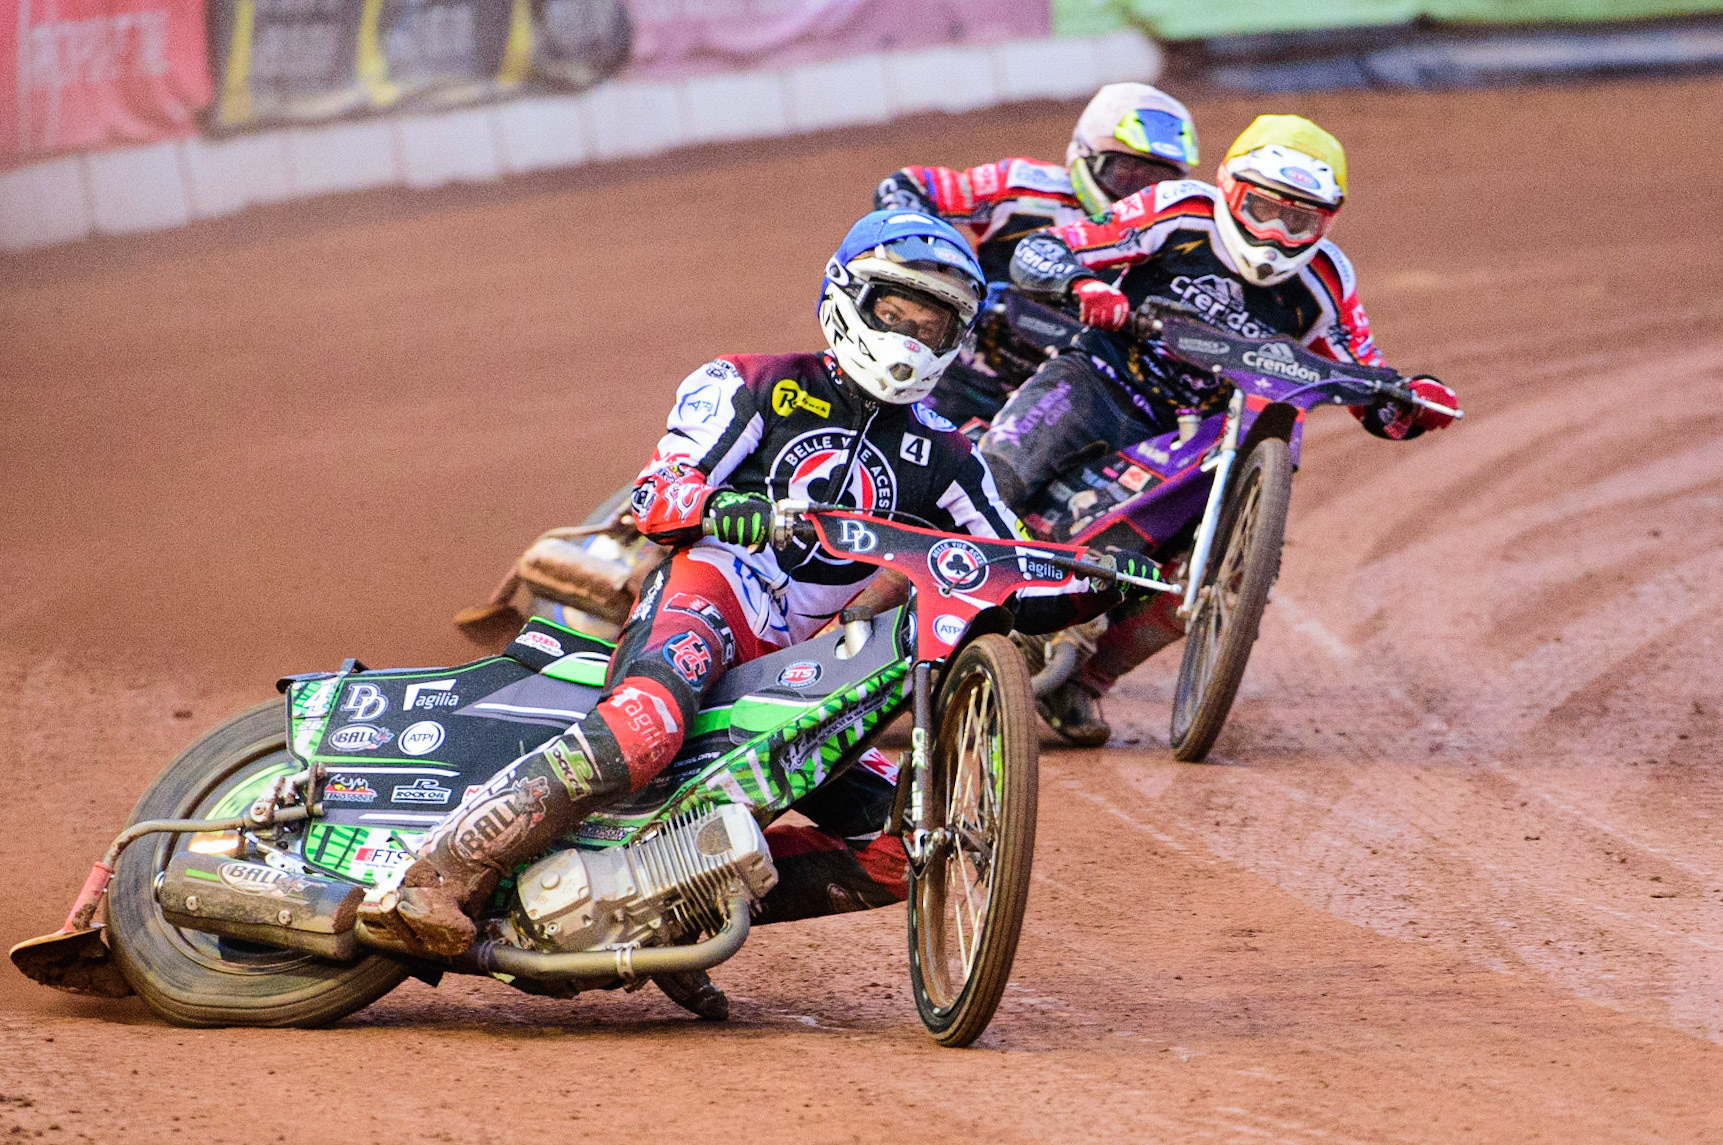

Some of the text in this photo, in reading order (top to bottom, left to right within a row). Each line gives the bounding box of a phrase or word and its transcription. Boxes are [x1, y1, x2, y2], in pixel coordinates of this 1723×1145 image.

[1242, 350, 1321, 382] Crendon
[905, 437, 925, 462] 4
[784, 436, 891, 509] BELLE VE ACES
[1028, 561, 1063, 580] agilia
[415, 692, 460, 710] agilia
[408, 732, 434, 743] ATPI
[395, 791, 429, 799] ROCK
[371, 849, 409, 865] FTS
